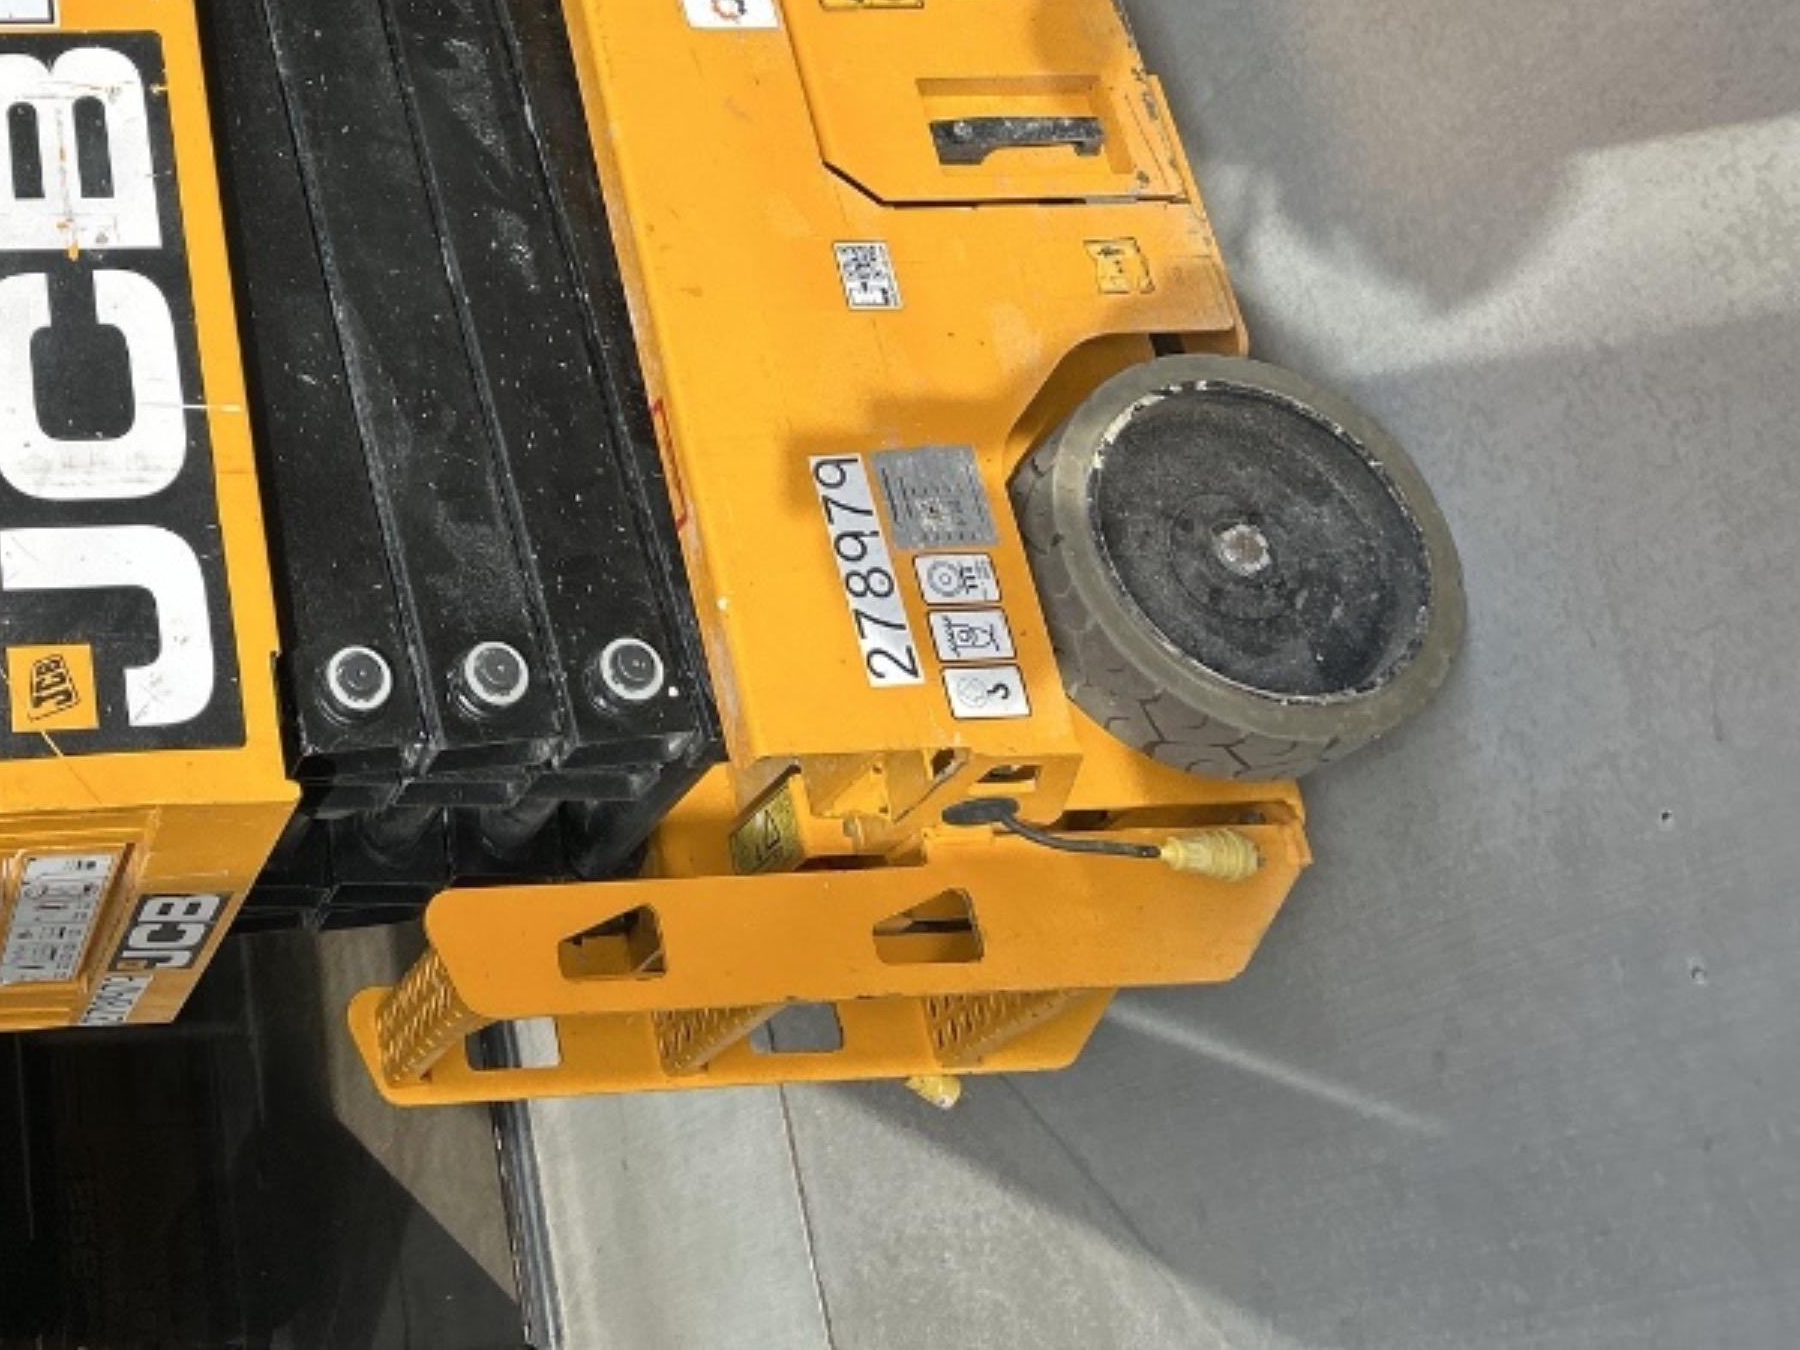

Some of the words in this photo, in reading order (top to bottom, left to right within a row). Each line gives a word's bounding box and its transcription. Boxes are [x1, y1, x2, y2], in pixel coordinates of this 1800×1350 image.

[811, 456, 920, 679] 278979
[29, 657, 74, 707] JCB
[121, 893, 221, 969] JCB
